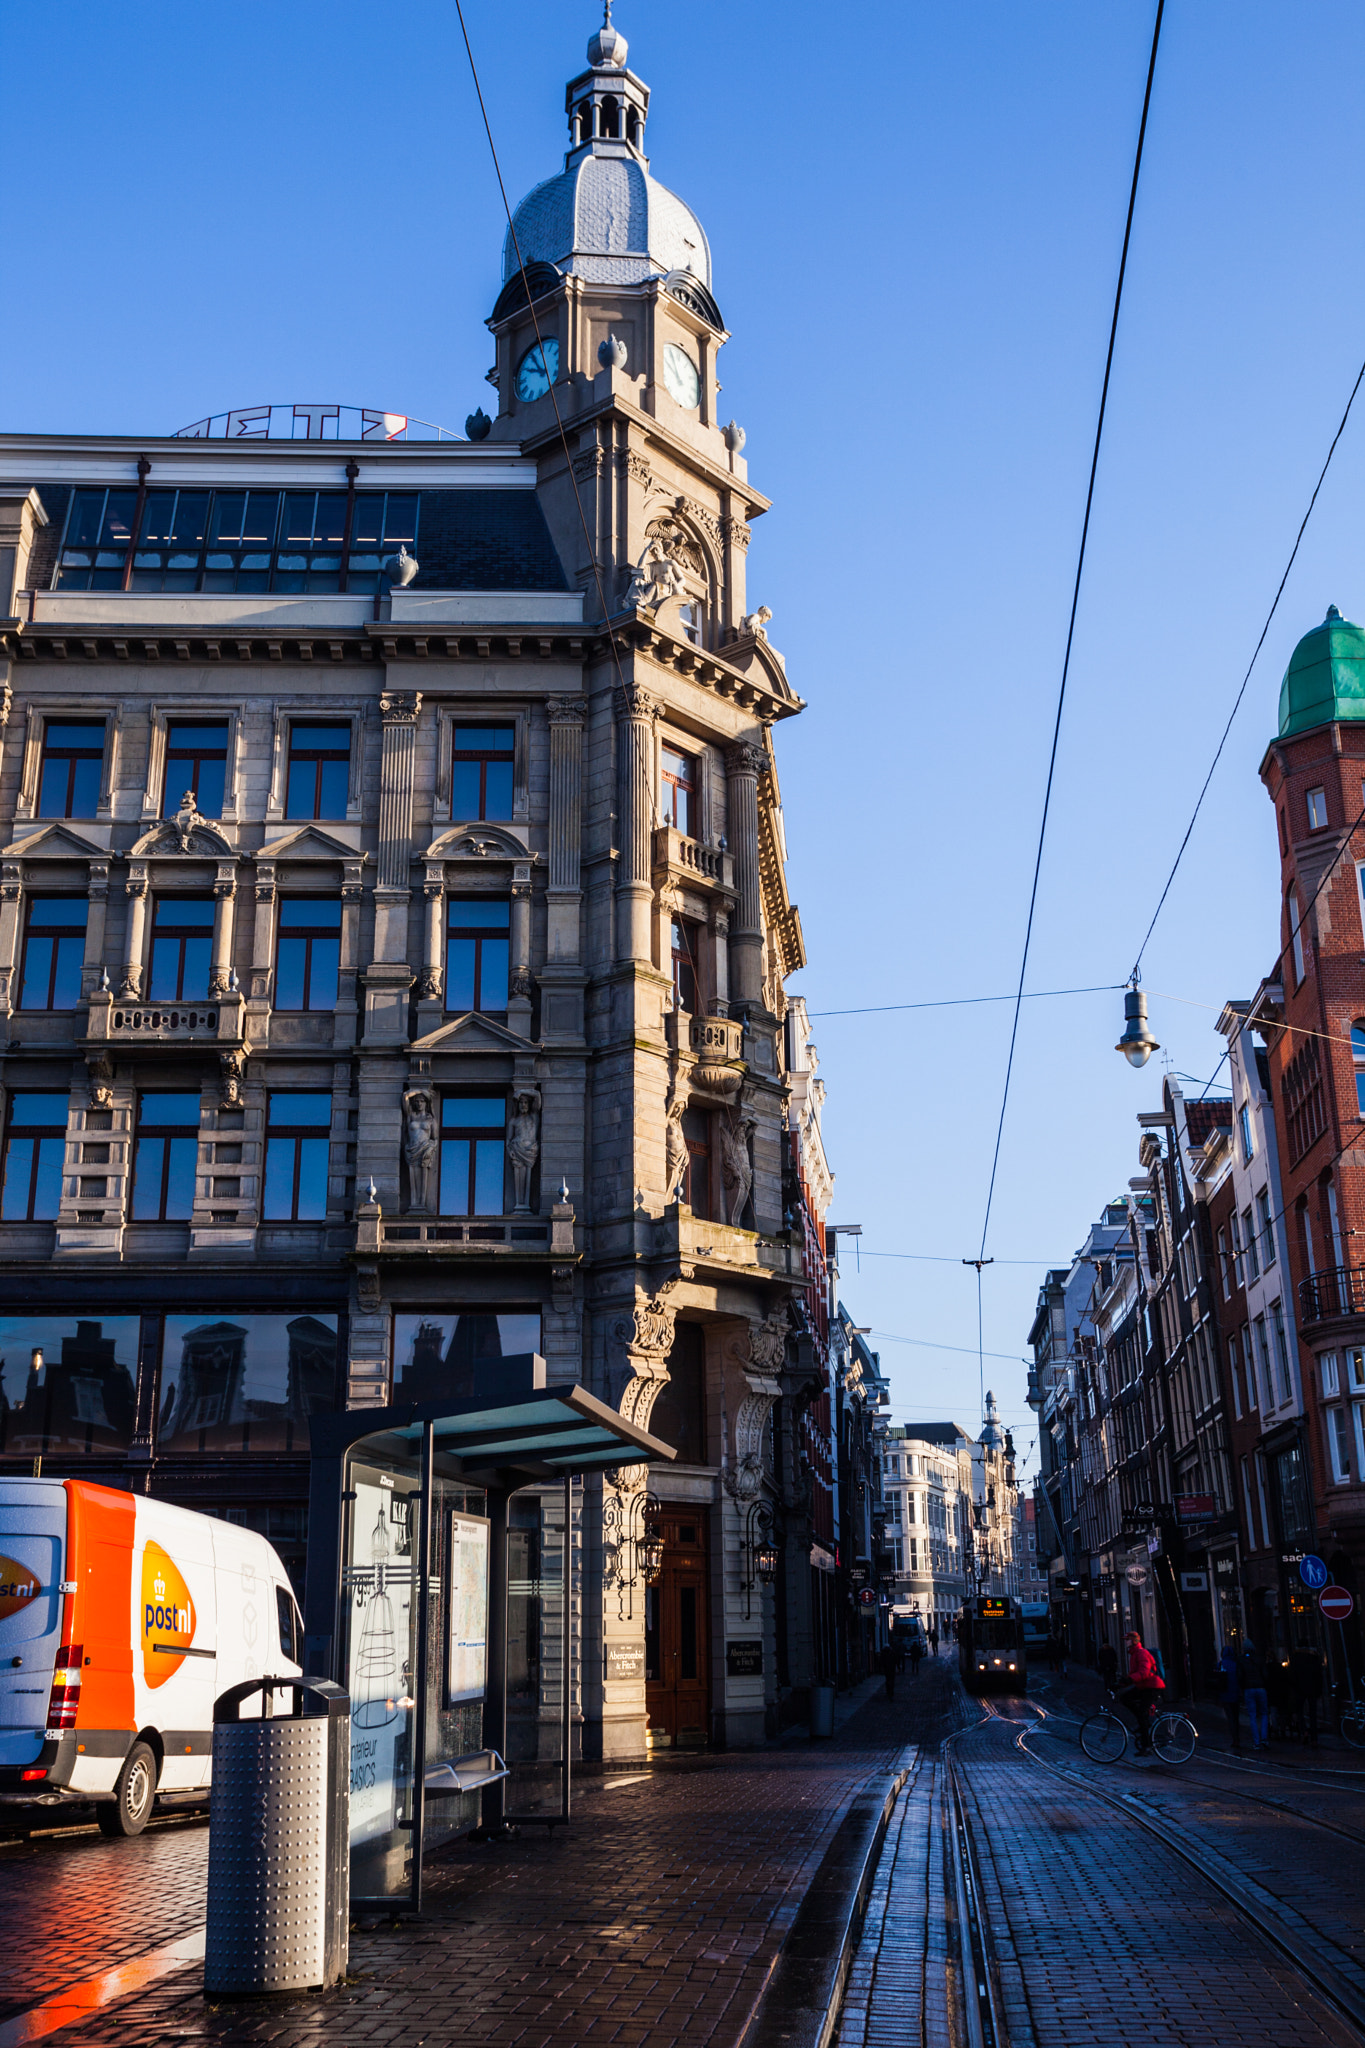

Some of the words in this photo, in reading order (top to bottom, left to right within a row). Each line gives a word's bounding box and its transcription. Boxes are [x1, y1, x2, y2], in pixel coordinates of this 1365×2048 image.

[392, 1501, 407, 1523] KAR
[0, 1578, 35, 1598] stnl
[986, 1599, 993, 1609] 5
[145, 1599, 192, 1638] postnl
[609, 1650, 644, 1660] Abercrombie
[730, 1648, 760, 1657] Abercrombie
[622, 1660, 637, 1670] Fitch
[351, 1737, 378, 1761] nterieur
[350, 1762, 376, 1795] BASICS
